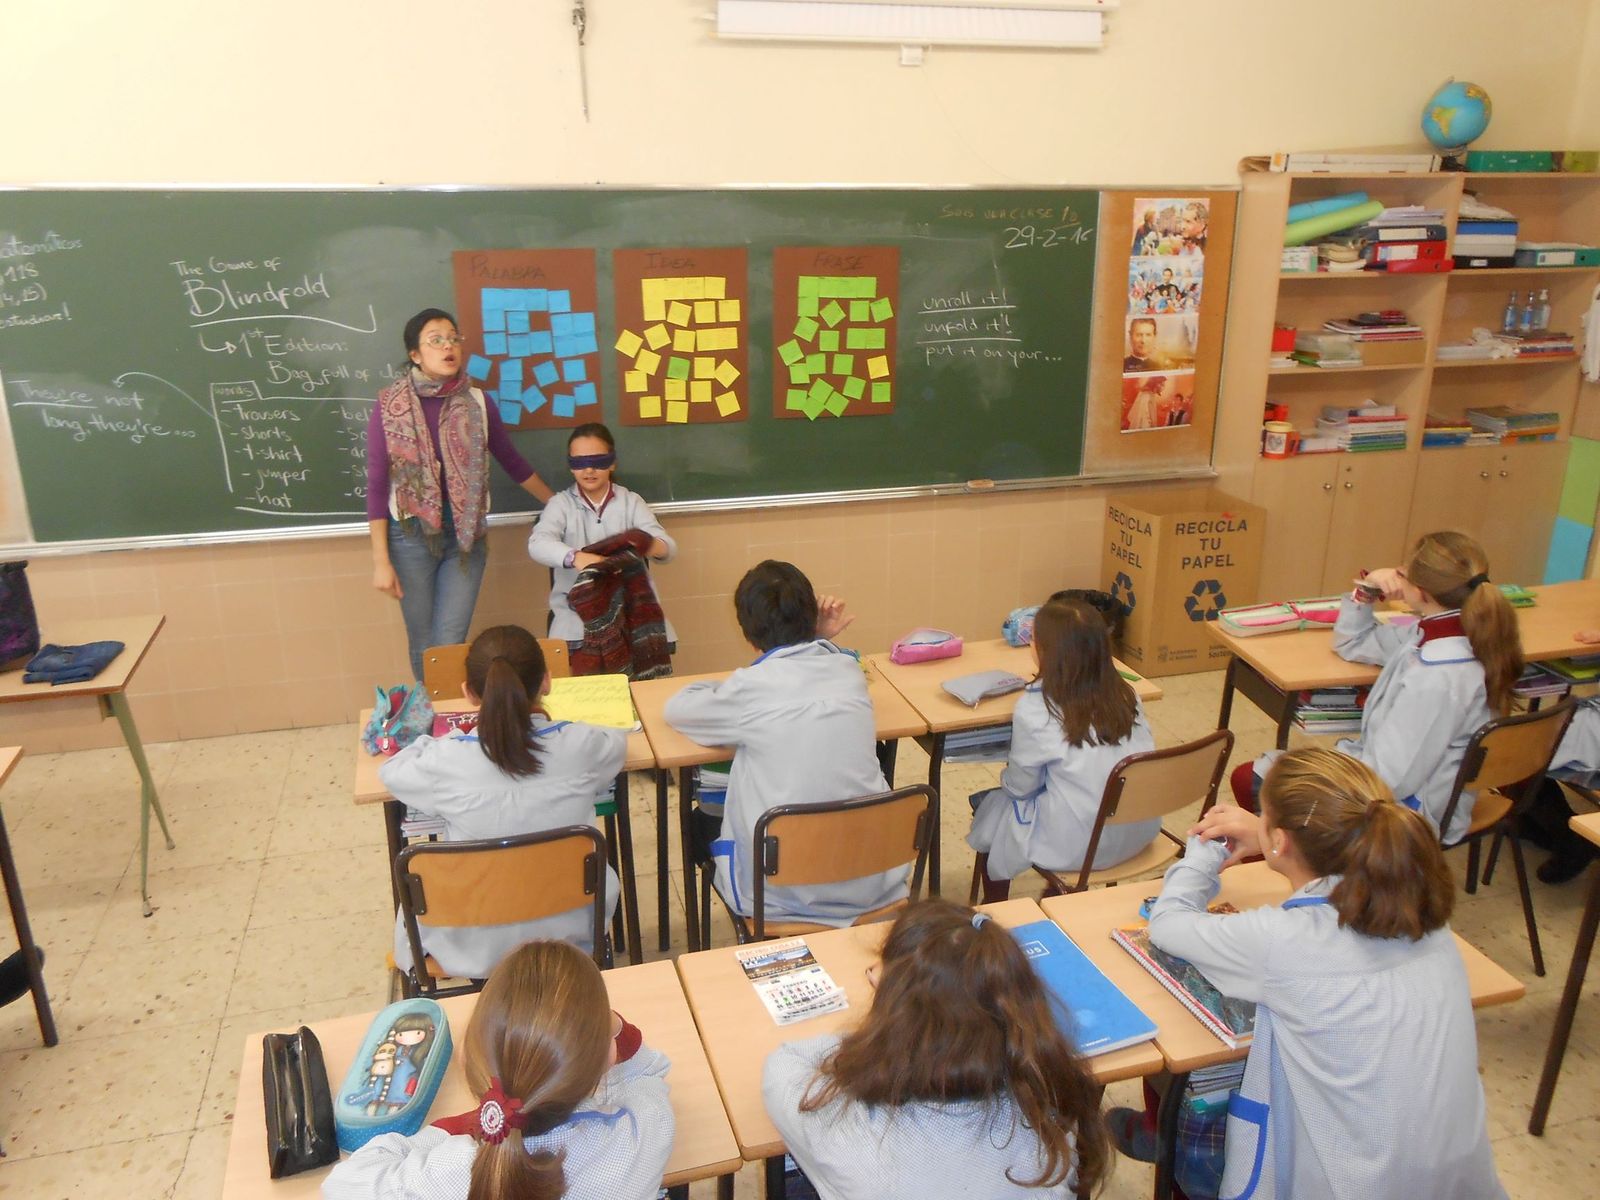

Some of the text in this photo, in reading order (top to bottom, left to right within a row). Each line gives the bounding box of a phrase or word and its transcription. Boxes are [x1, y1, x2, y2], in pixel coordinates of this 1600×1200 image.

[1003, 225, 1093, 248] 29-2-16
[169, 256, 282, 276] The Game of
[183, 273, 330, 317] Blindfold
[923, 290, 972, 310] unroll
[924, 317, 978, 337] unfold
[925, 345, 953, 366] put
[984, 349, 1002, 358] on
[355, 369, 370, 383] of
[105, 392, 145, 410] not
[256, 468, 311, 490] jumper
[256, 491, 293, 508] hat
[1108, 506, 1152, 537] RECICLA
[1175, 519, 1248, 536] RECICLA
[1120, 530, 1133, 547] TU
[1199, 538, 1222, 551] TU
[1110, 542, 1143, 569] PAPEL
[1181, 554, 1235, 570] PAPEL
